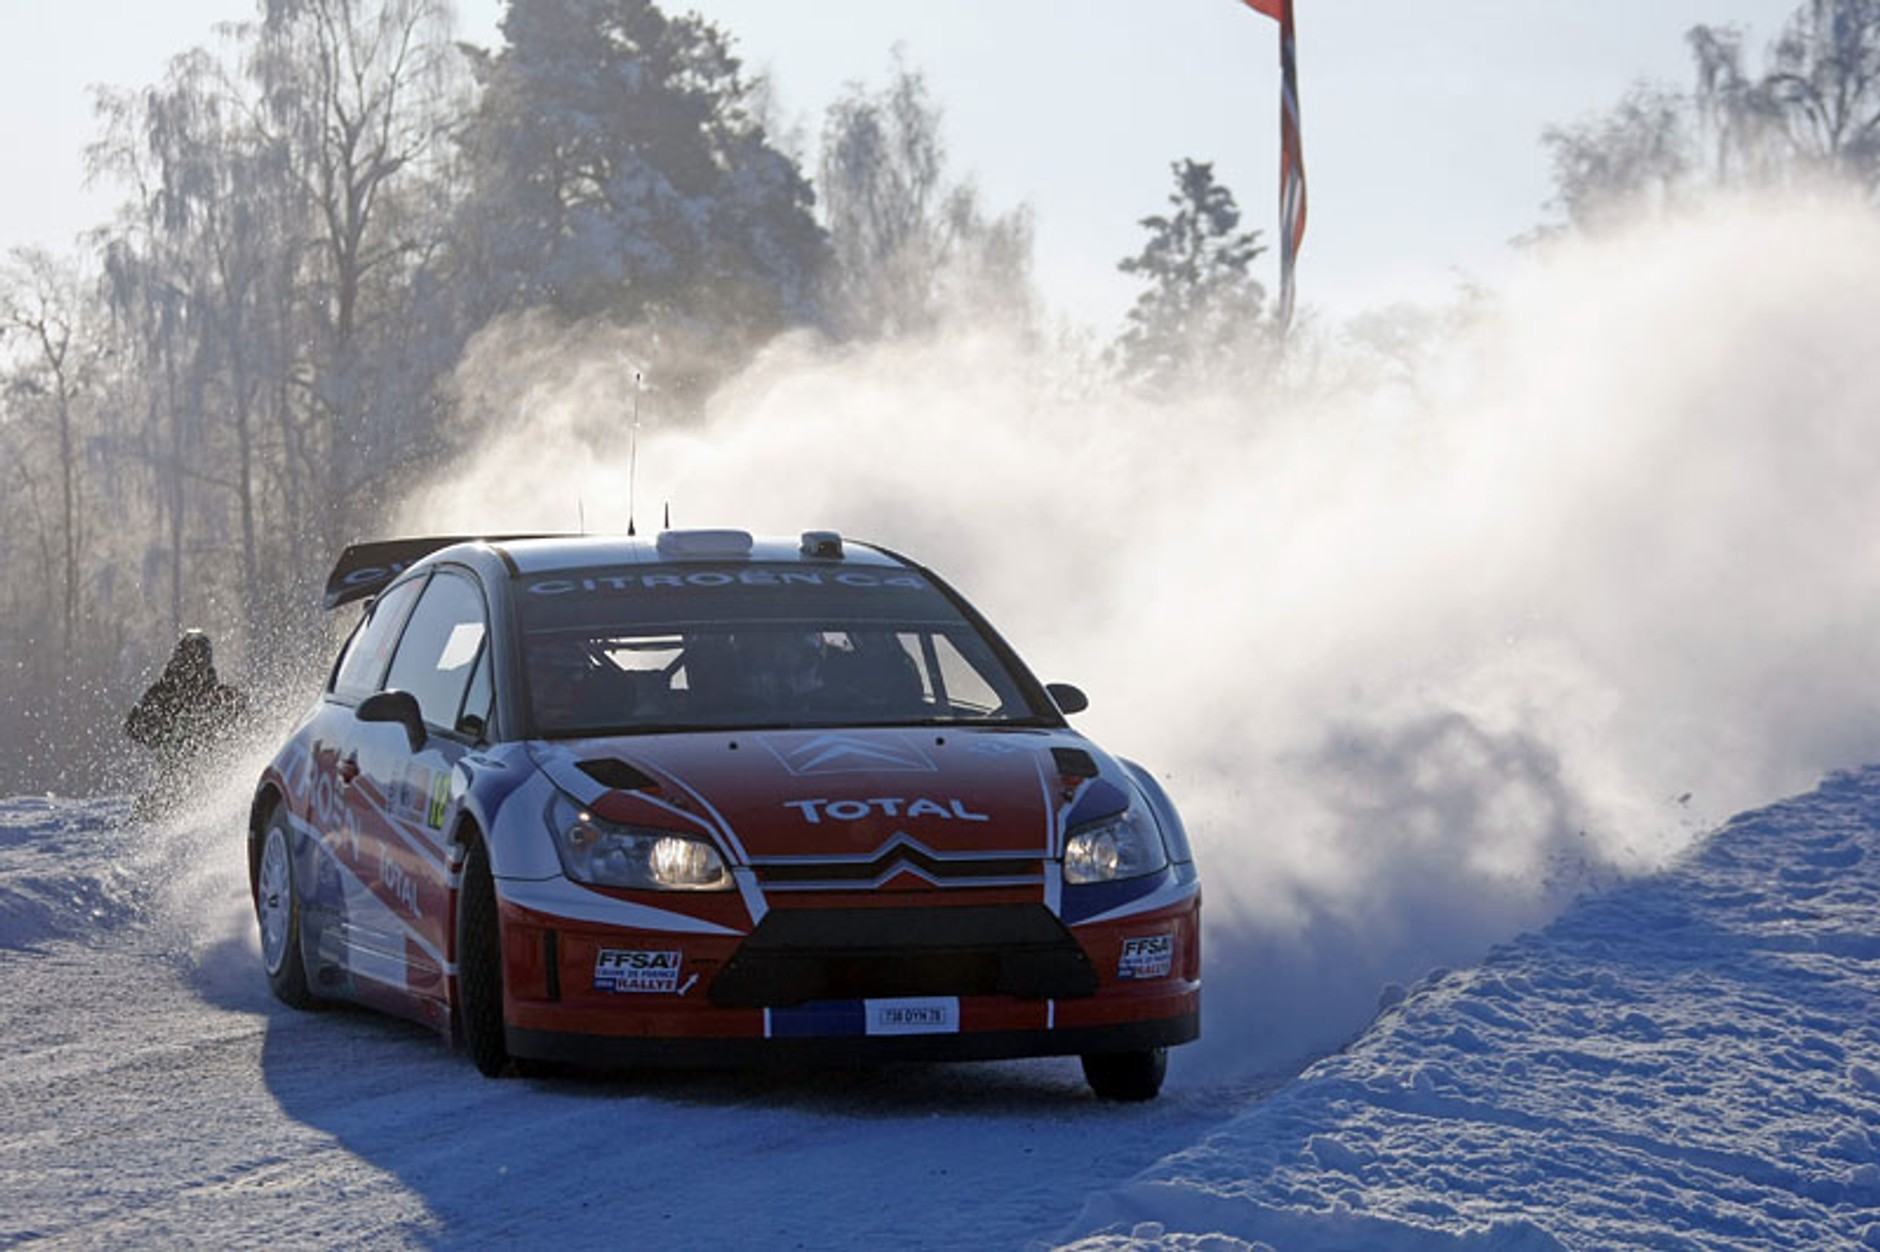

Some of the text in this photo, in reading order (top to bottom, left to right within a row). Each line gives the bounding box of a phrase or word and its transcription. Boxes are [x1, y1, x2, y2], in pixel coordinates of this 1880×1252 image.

[528, 568, 928, 595] CITROËN C4
[783, 798, 989, 824] TOTAL
[377, 841, 421, 918] TOTAL
[599, 951, 669, 969] FFSA
